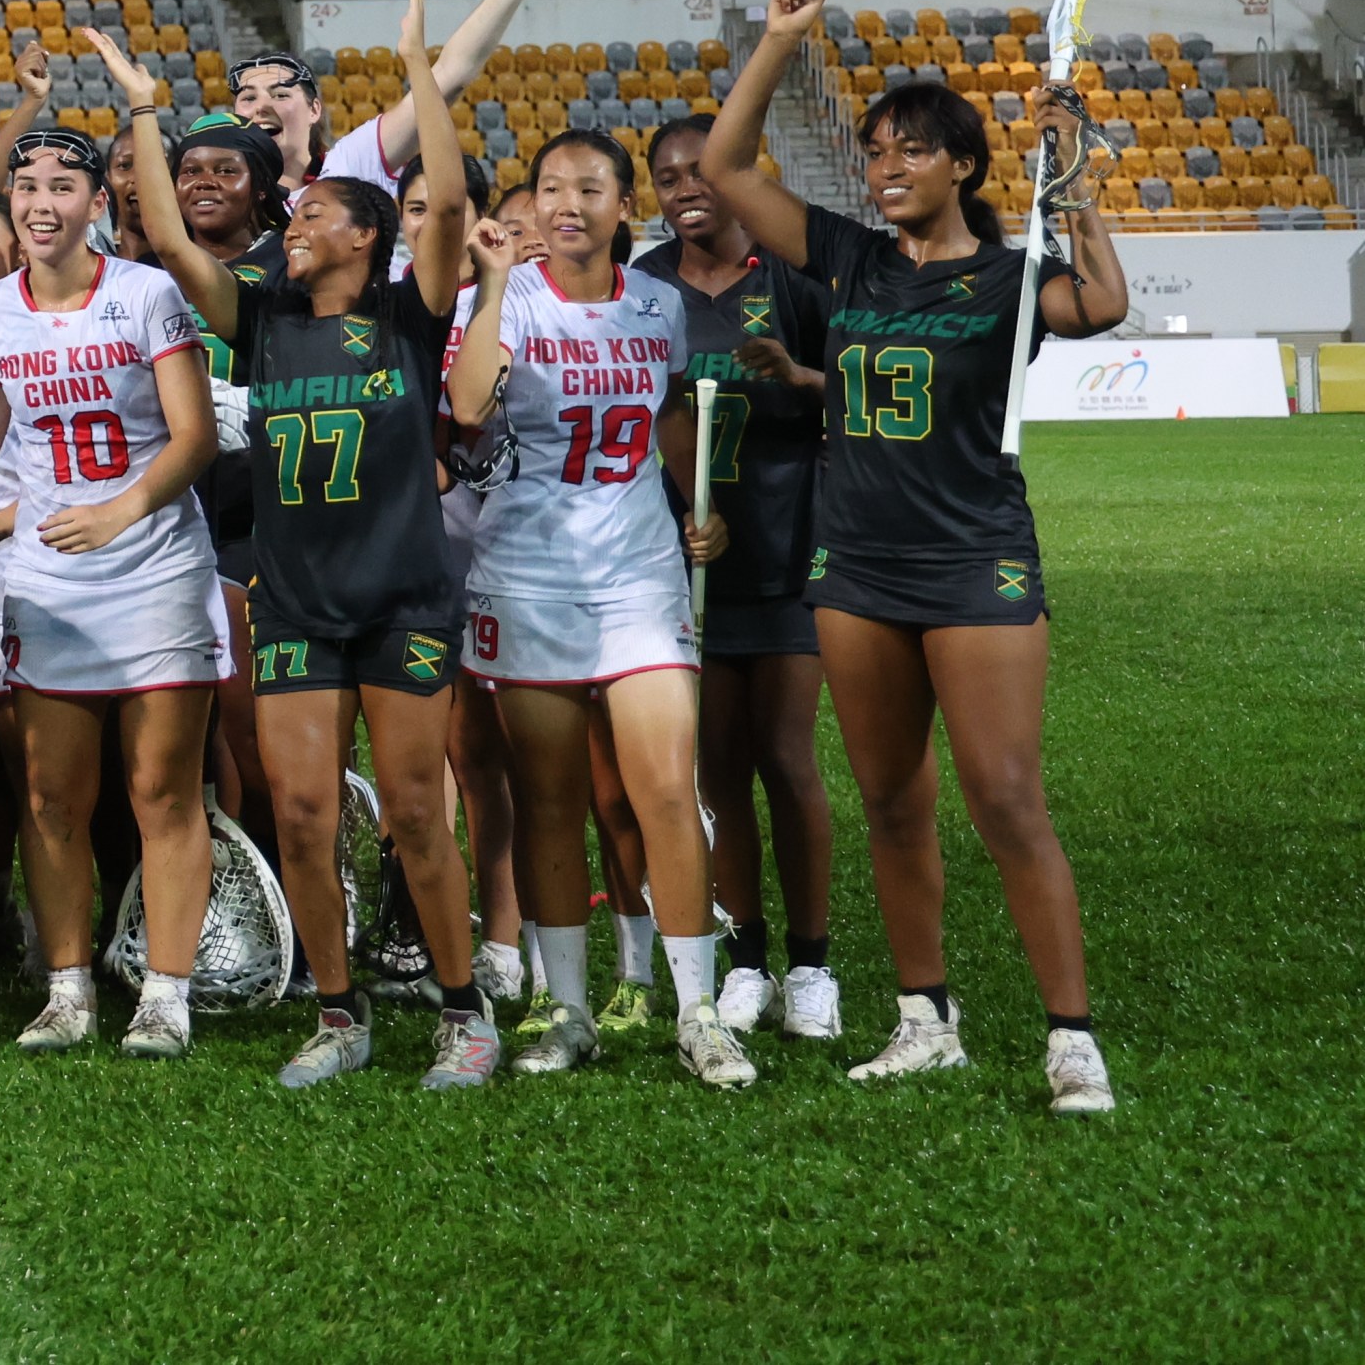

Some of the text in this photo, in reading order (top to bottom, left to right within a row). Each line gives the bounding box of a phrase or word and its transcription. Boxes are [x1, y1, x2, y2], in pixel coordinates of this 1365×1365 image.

[65, 340, 143, 373] KONG
[524, 336, 670, 365] HONG KON
[23, 374, 113, 409] CHINA
[562, 367, 654, 396] CHINA
[837, 344, 934, 441] 13
[32, 409, 130, 485] 10
[265, 408, 365, 505] 77
[559, 404, 653, 485] 19
[684, 392, 751, 482] 7
[257, 639, 309, 683] 77
